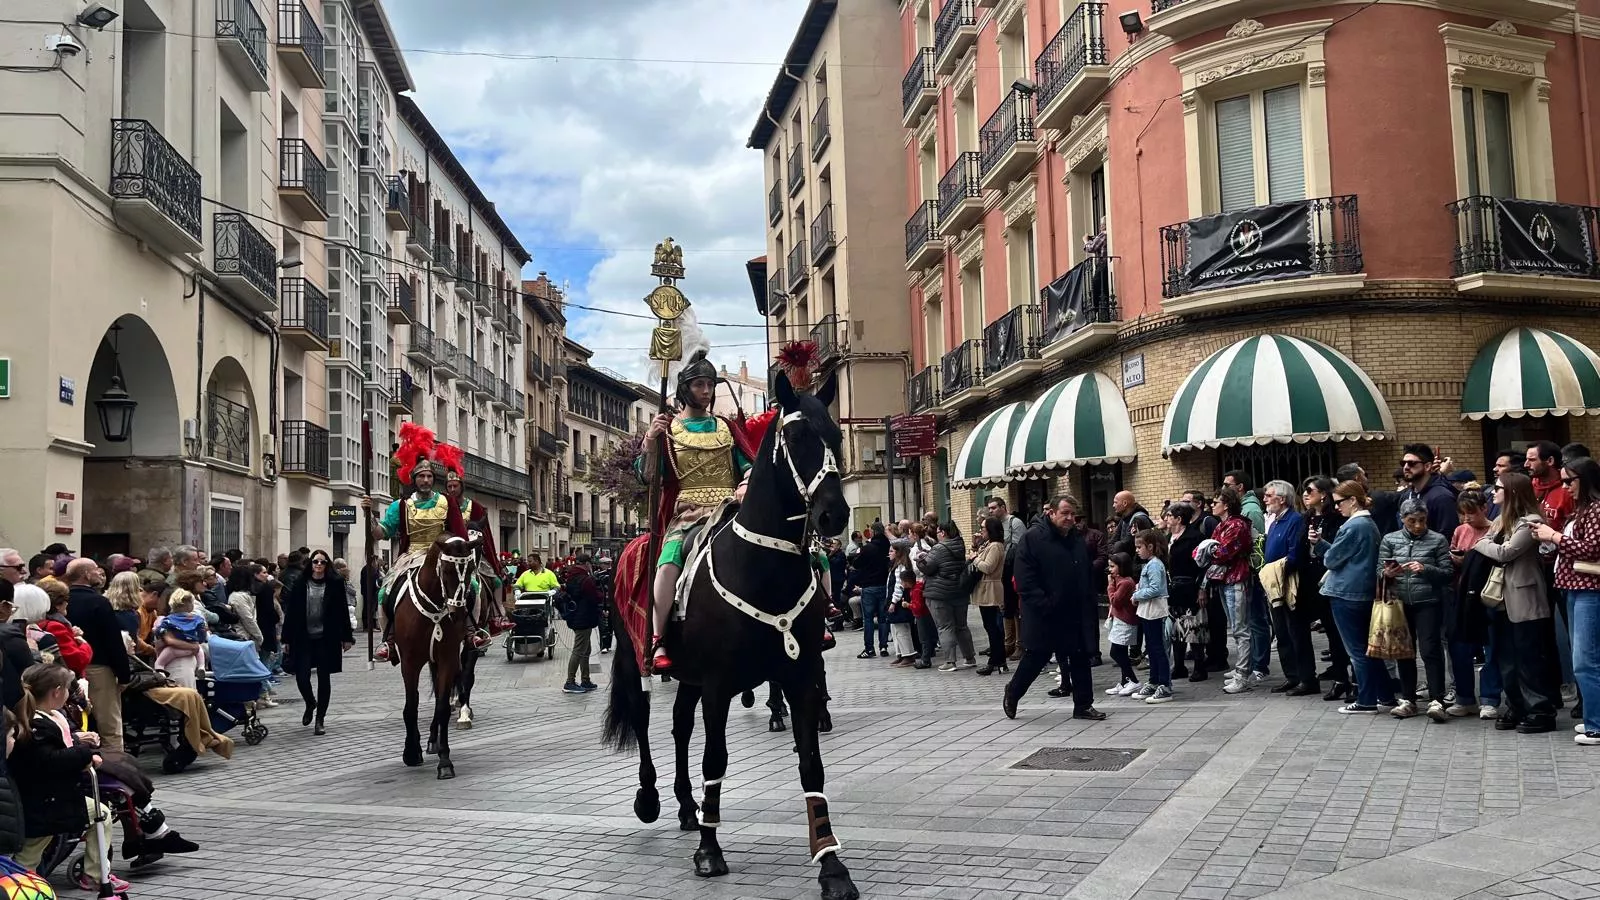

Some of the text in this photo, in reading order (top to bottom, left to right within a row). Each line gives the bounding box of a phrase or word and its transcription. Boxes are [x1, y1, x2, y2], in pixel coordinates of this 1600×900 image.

[1199, 258, 1302, 280] SEMANA SANTA
[1510, 259, 1551, 269] SEMANA
[652, 293, 684, 313] SPQR
[1125, 373, 1141, 384] ALTO
[330, 508, 355, 516] embou
